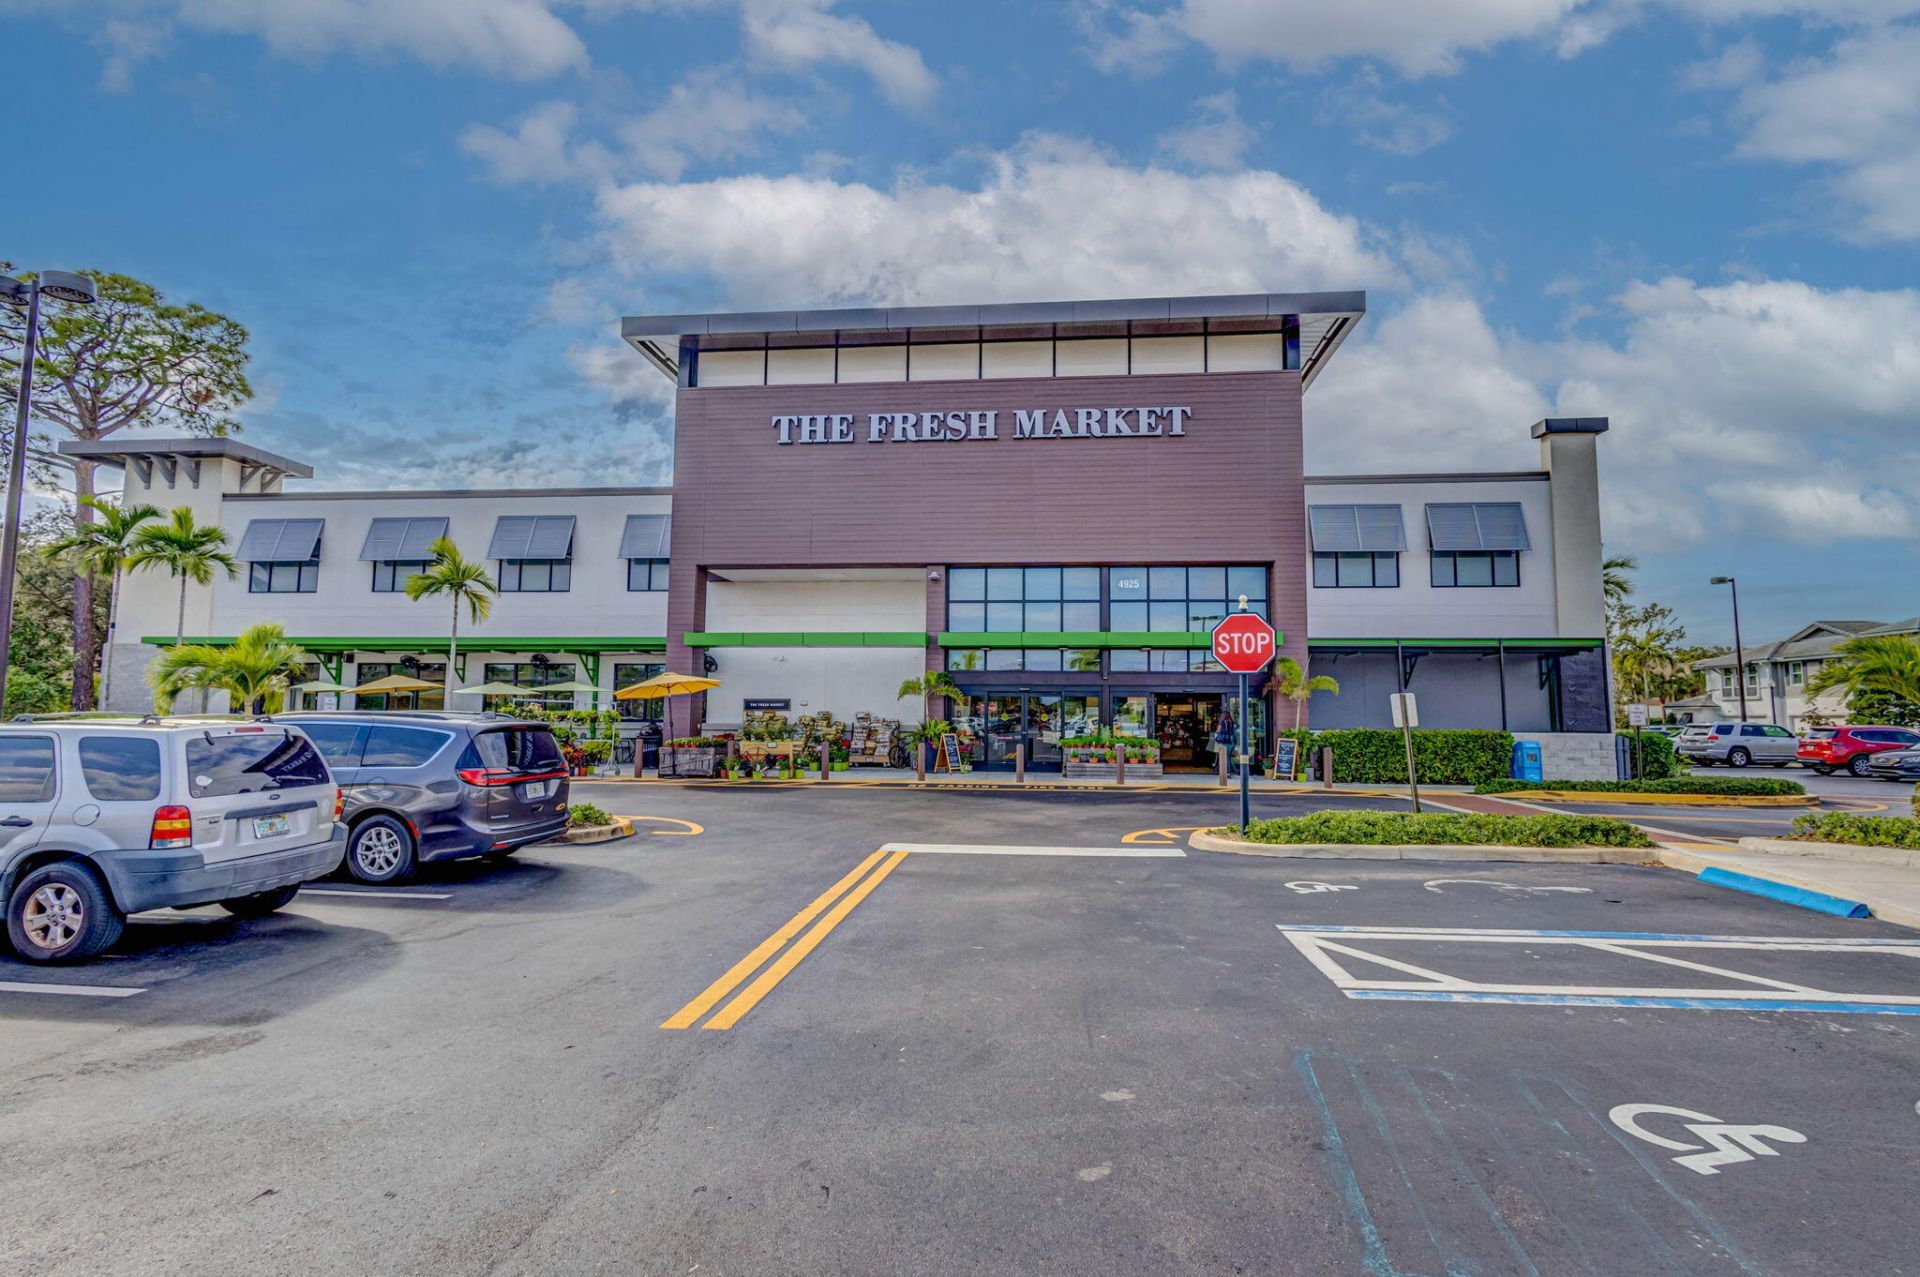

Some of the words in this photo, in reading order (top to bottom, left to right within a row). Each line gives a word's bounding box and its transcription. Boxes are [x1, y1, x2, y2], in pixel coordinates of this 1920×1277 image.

[771, 414, 855, 445] THE
[867, 410, 999, 443] FRESH
[1012, 406, 1192, 440] MARKET
[1118, 579, 1140, 589] 4925
[1217, 632, 1271, 655] STOP
